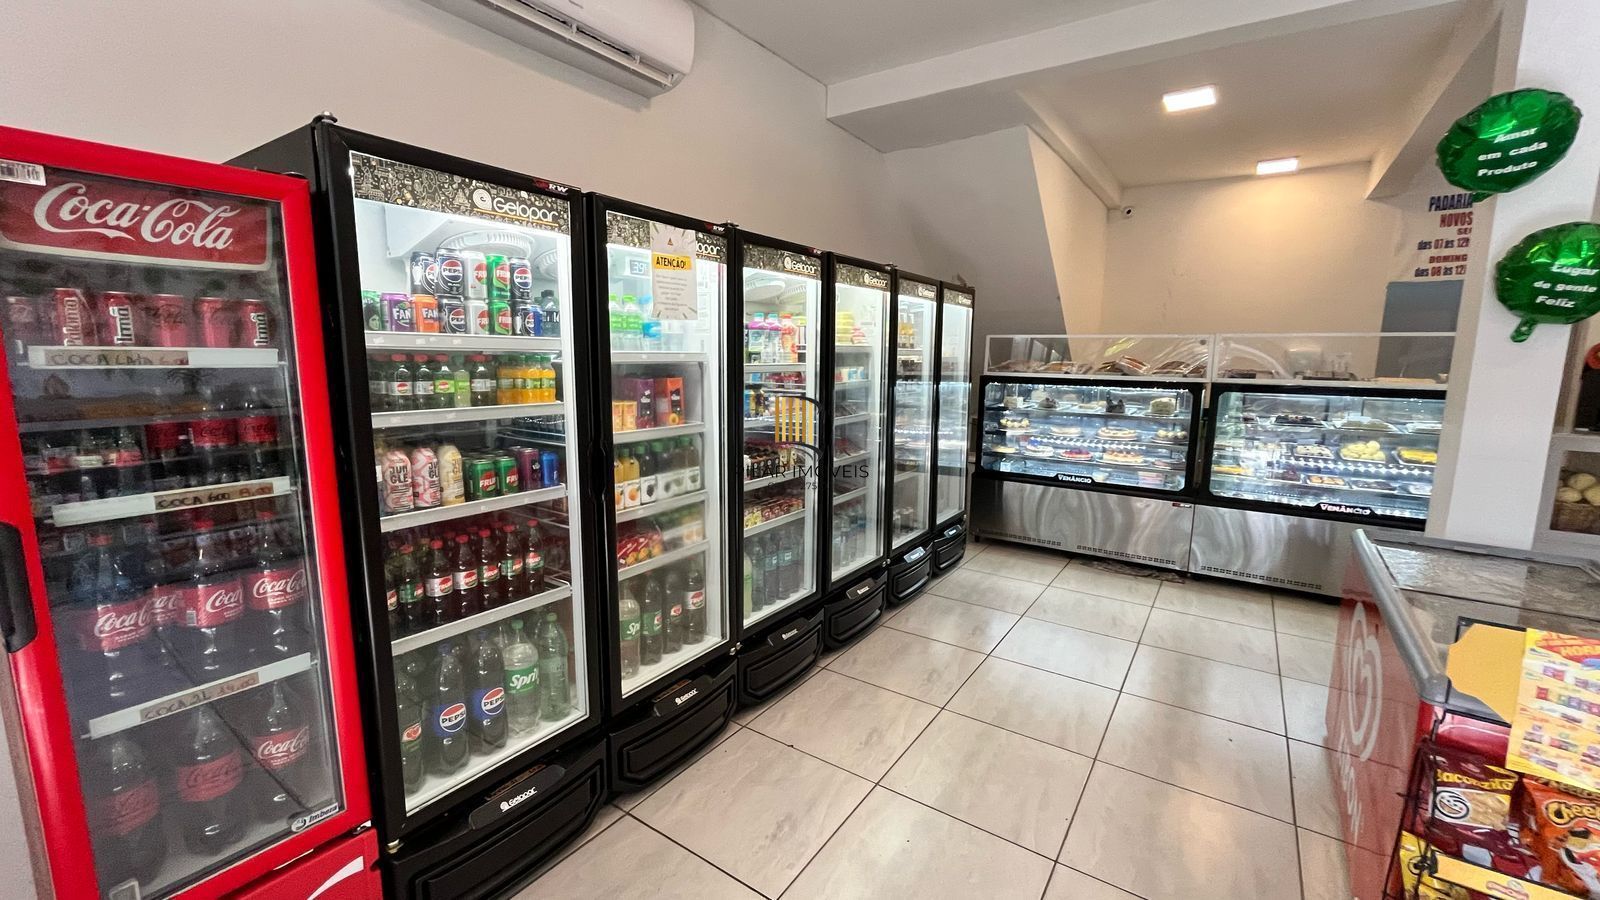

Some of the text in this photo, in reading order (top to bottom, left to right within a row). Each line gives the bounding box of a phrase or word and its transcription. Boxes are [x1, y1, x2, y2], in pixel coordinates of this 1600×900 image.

[1493, 127, 1538, 143] Amor
[1477, 141, 1549, 161] em cada
[1477, 161, 1538, 177] Produto
[33, 182, 241, 250] Coca-Cola
[493, 197, 559, 223] Gelopar
[1440, 211, 1474, 228] NOVOS
[1533, 280, 1598, 293] de gente
[1535, 295, 1576, 308] Feliz
[157, 496, 203, 509] COCA
